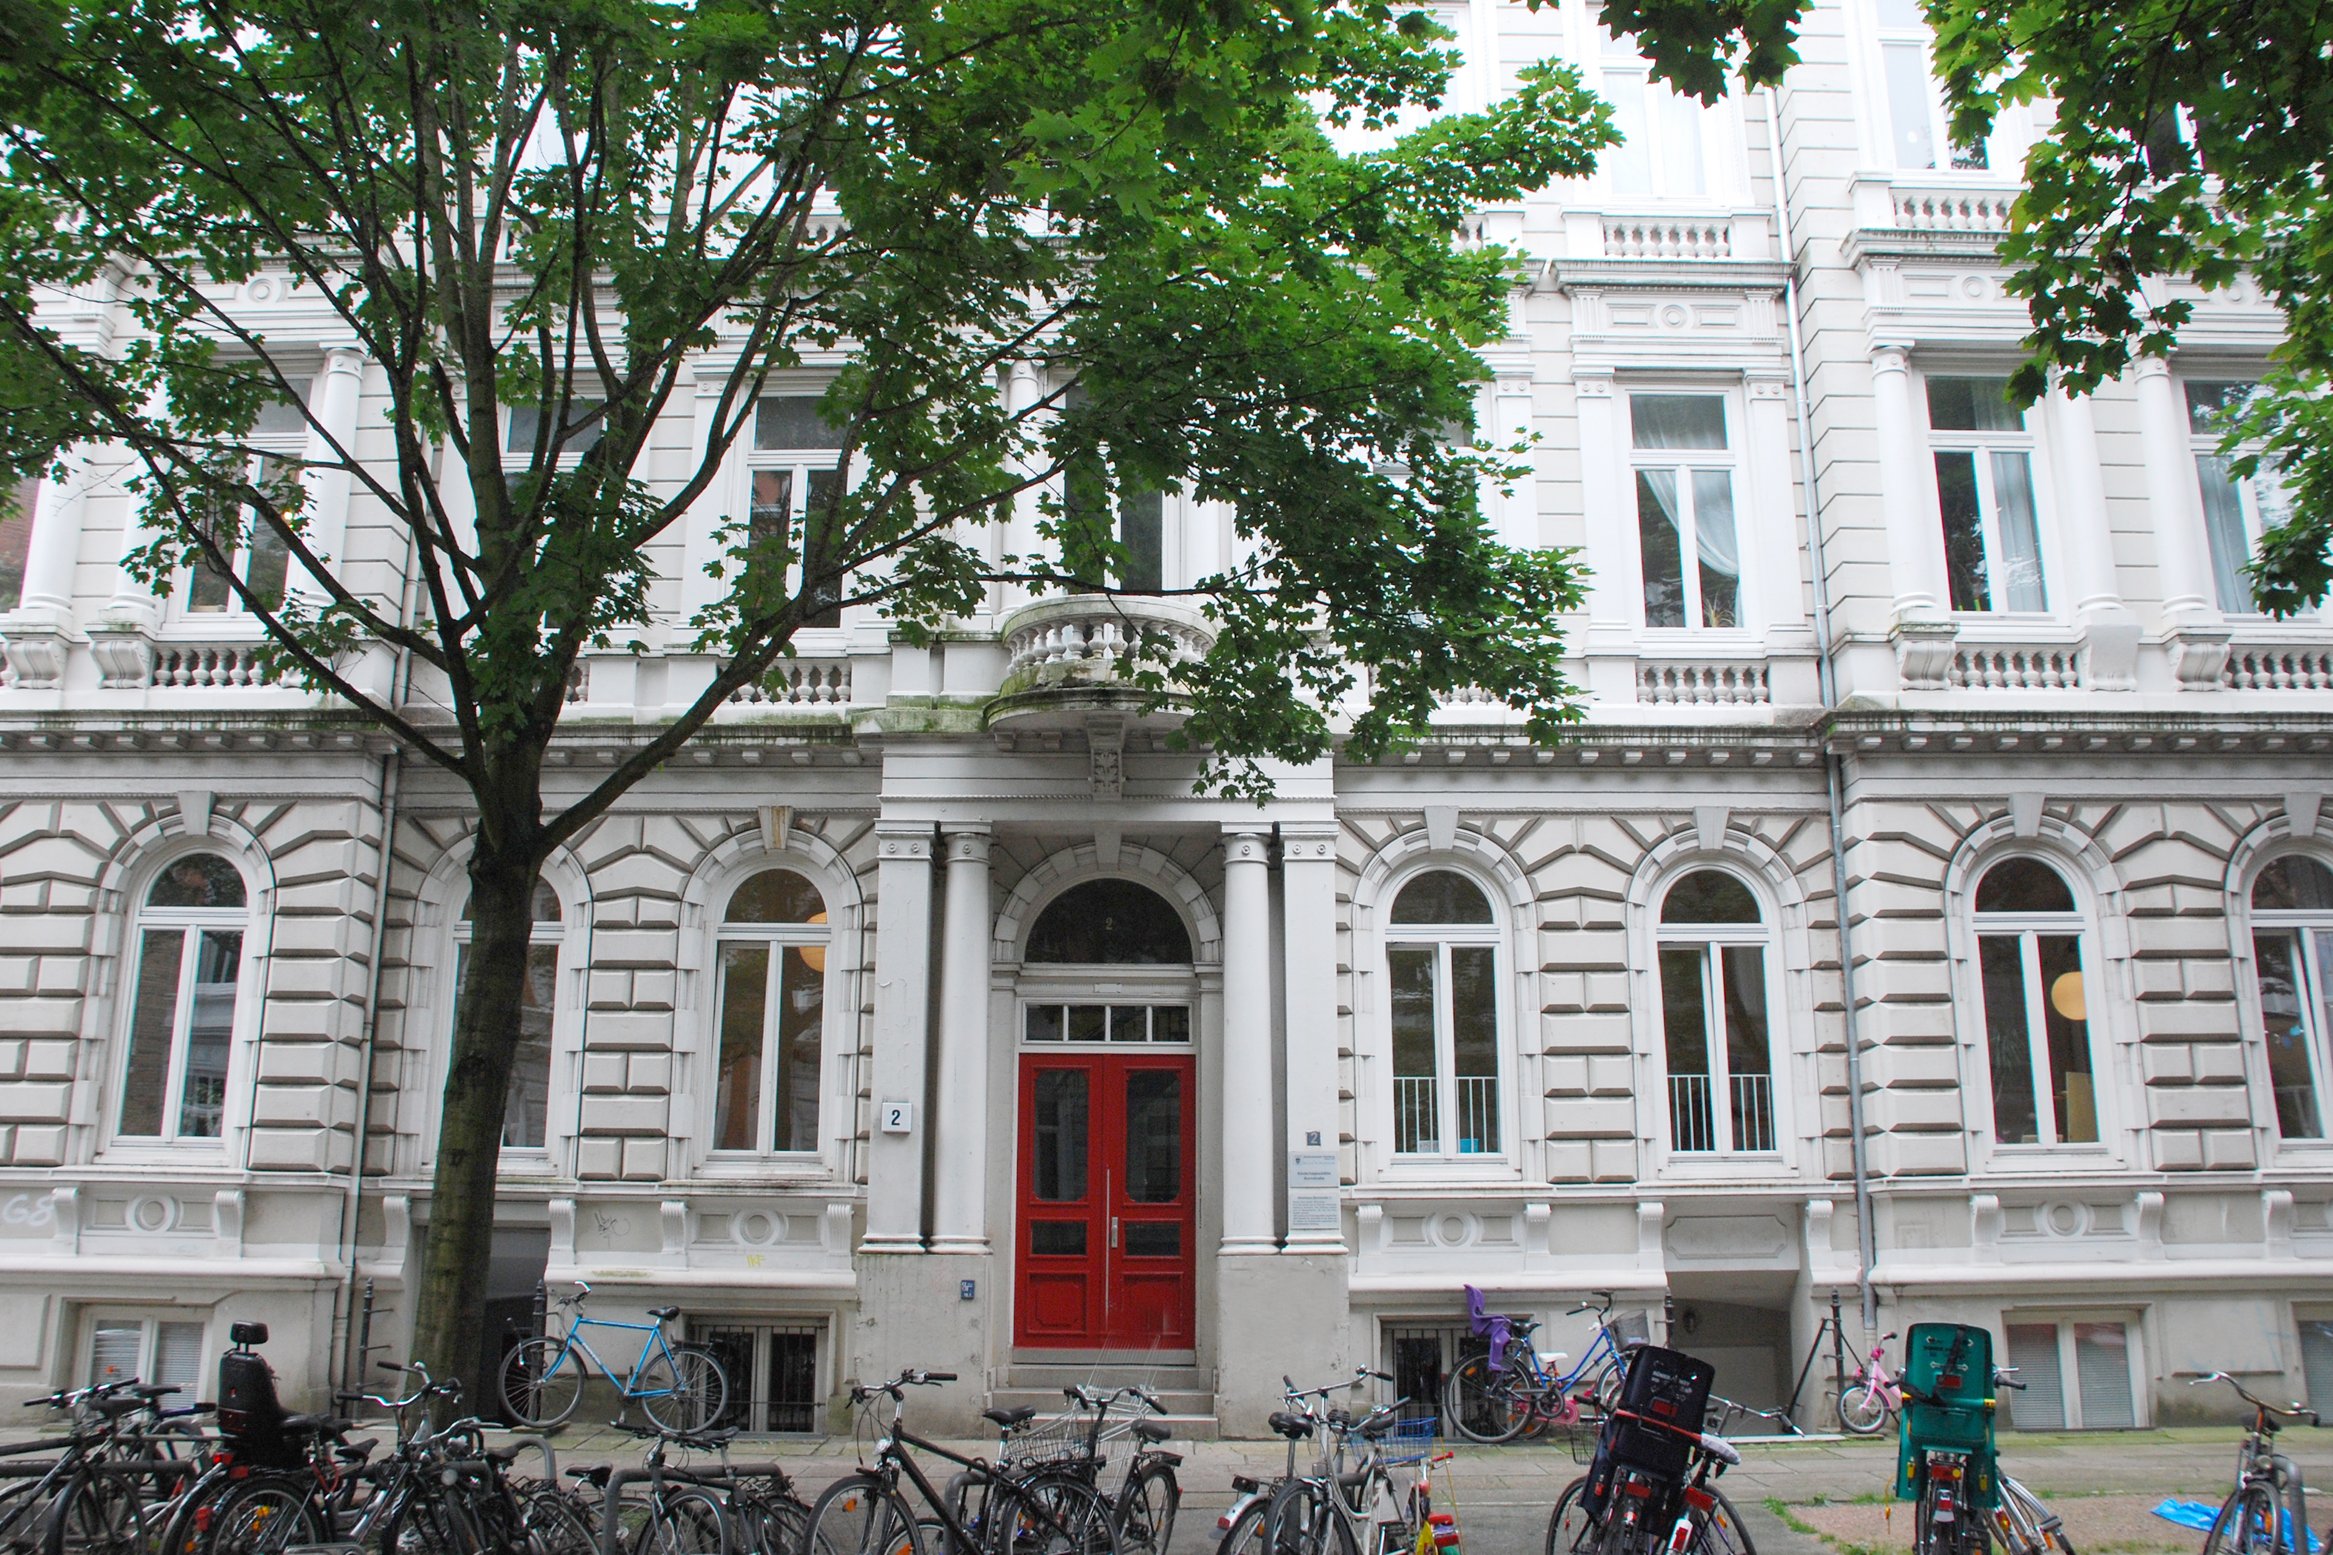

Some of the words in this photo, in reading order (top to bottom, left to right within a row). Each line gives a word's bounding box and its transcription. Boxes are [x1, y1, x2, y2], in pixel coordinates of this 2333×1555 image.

[1105, 916, 1113, 930] 2
[891, 1109, 901, 1126] 2
[1310, 1132, 1319, 1144] 2
